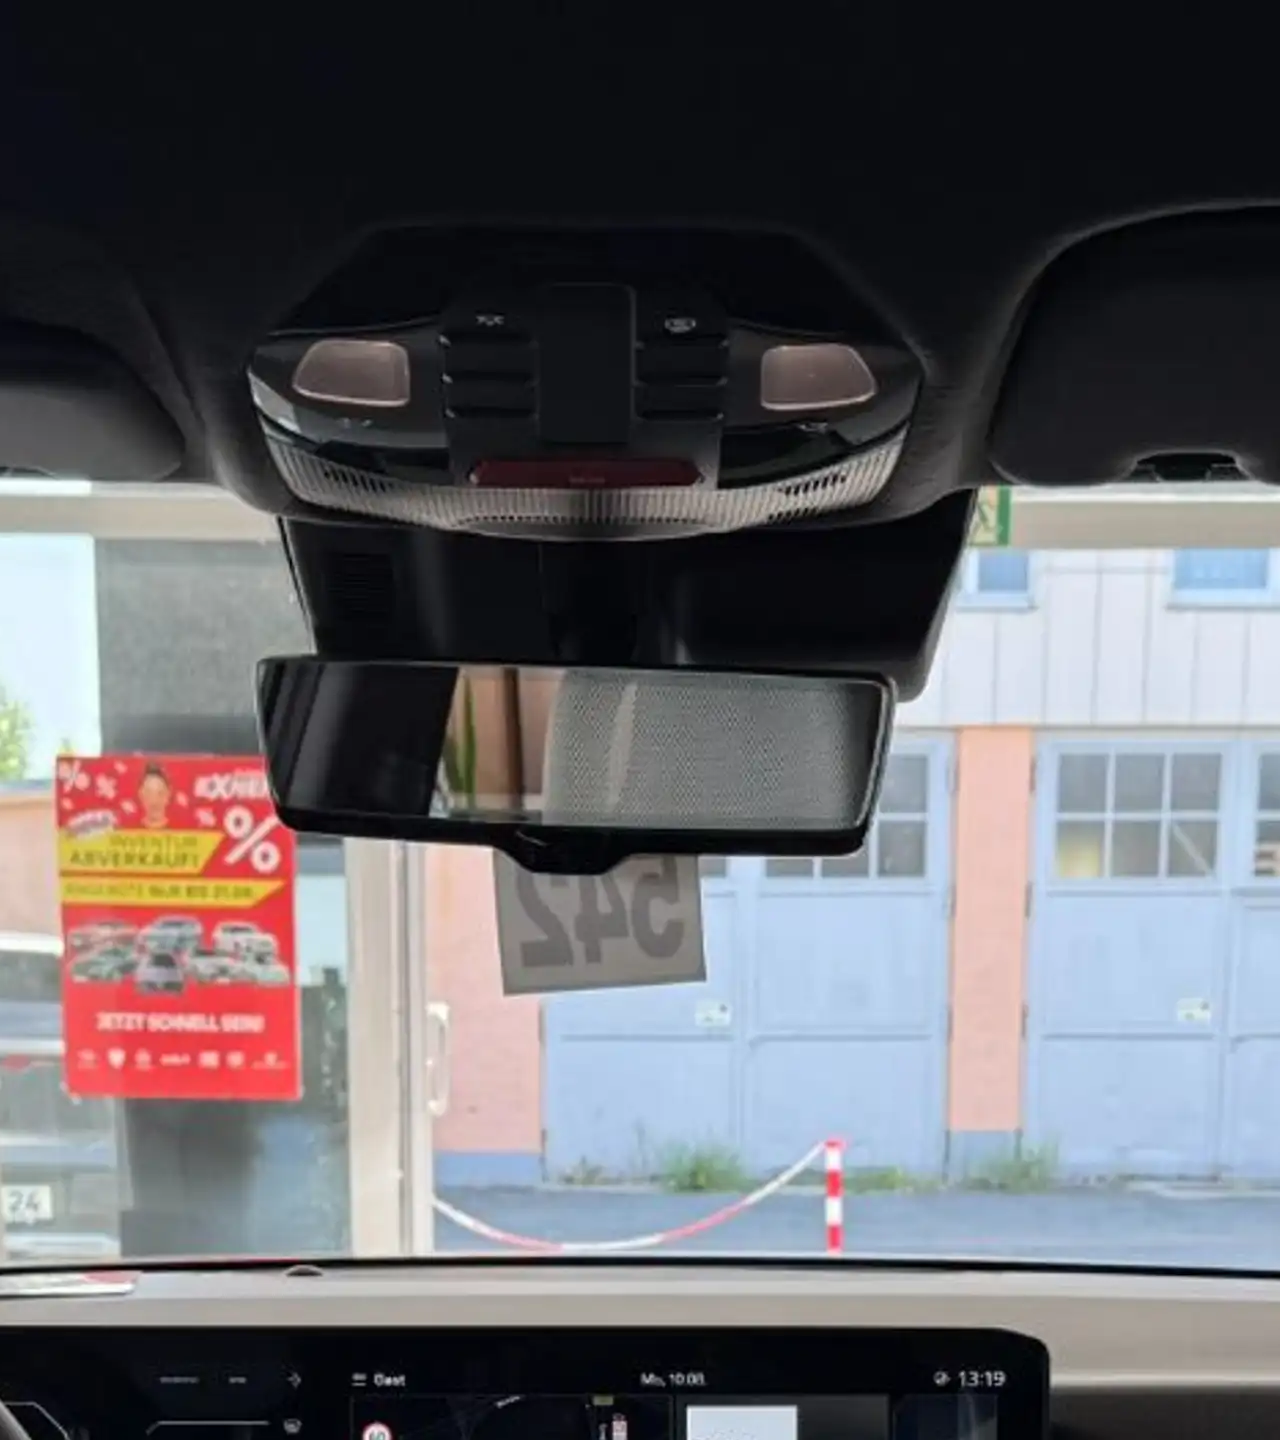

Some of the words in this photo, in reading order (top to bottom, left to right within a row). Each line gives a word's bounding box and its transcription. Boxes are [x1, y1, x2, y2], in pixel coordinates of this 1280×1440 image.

[110, 835, 199, 848] INVENTUR
[70, 850, 200, 868] ABVERKAUF!
[96, 1012, 147, 1032] JETZT
[146, 1012, 219, 1034] SCHNELL
[372, 1372, 407, 1388] Gast
[958, 1369, 1007, 1388] 13:19
